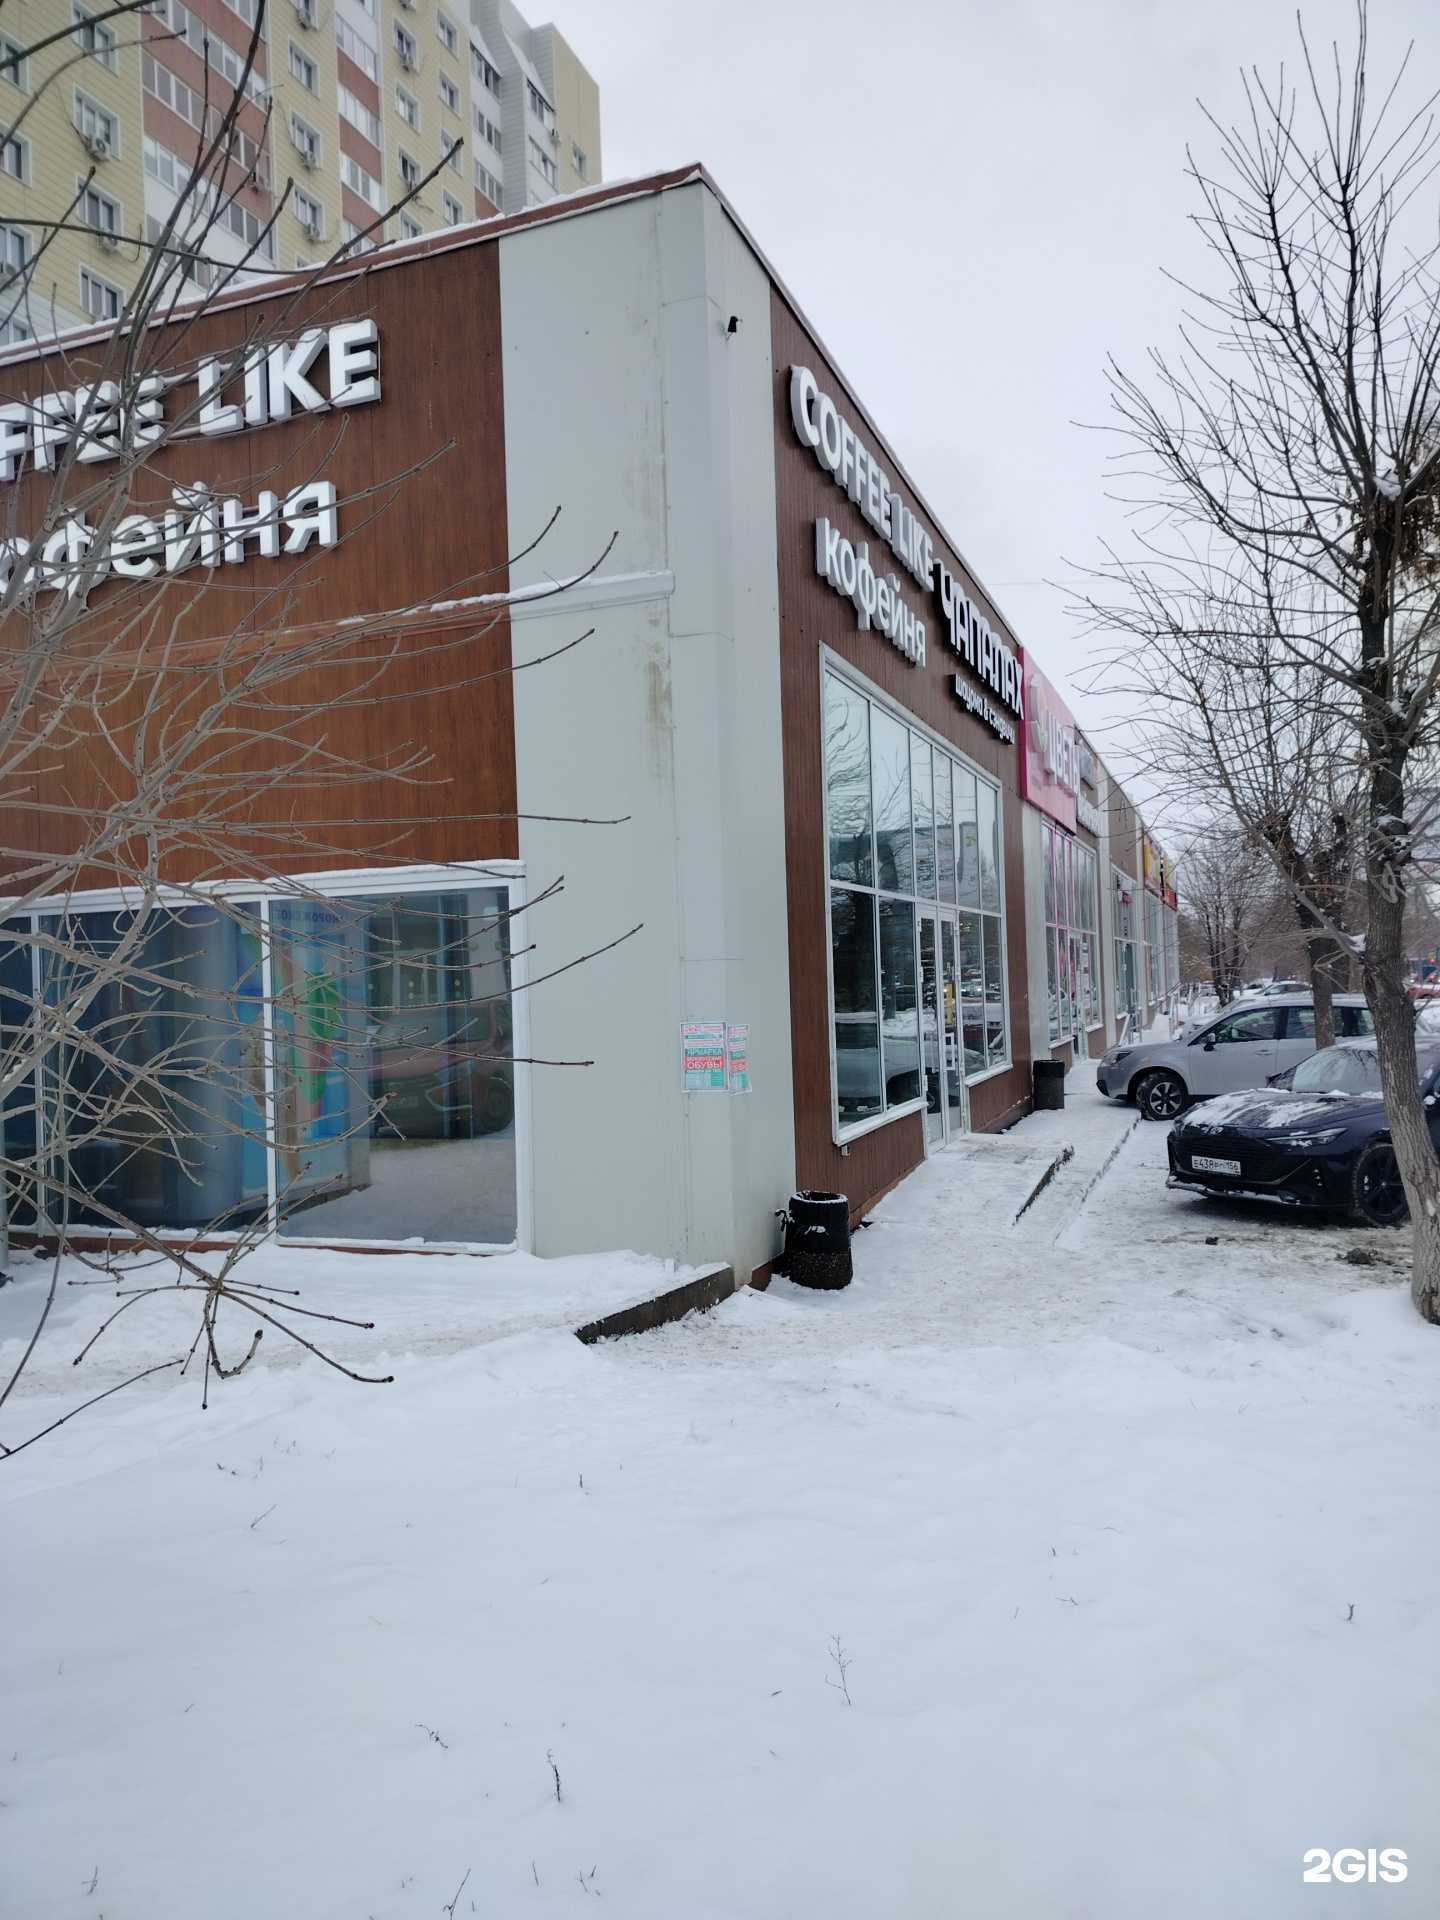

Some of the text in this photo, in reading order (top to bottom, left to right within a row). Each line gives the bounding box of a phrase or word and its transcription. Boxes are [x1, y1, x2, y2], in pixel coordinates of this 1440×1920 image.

[199, 318, 382, 436] LIKE
[790, 365, 935, 593] COFFEE LIKE
